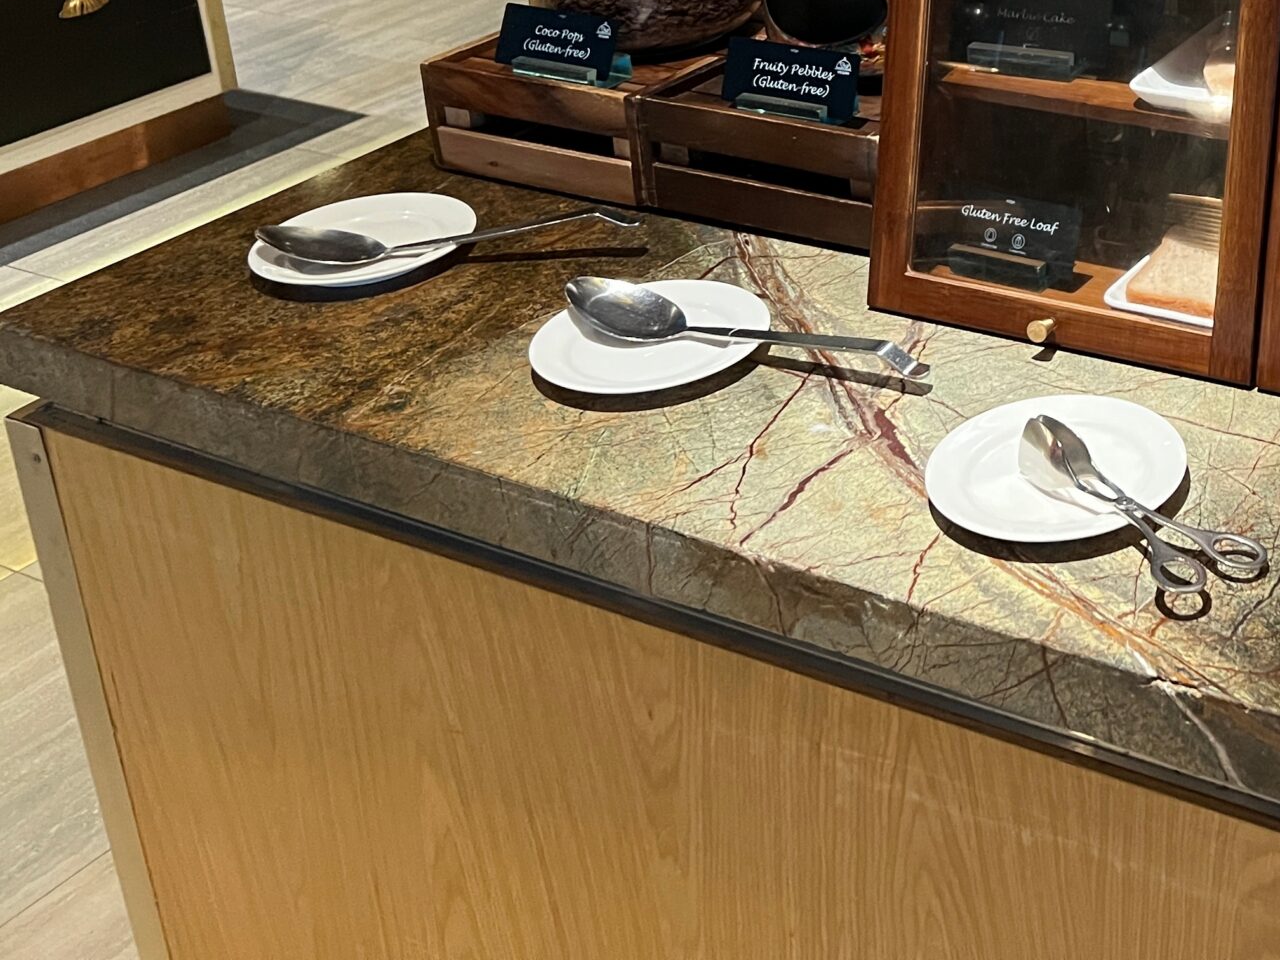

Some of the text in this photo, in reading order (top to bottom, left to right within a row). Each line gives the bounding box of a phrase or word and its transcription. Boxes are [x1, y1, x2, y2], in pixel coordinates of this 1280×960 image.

[1043, 12, 1075, 25] Cake
[535, 24, 560, 37] Coco
[561, 28, 583, 44] Pops
[523, 37, 591, 60] (Gluten-free)
[753, 58, 836, 81] Fruity Pebbles
[753, 74, 830, 98] (Gluten-free)
[961, 204, 1060, 236] Gluten Free Loaf
